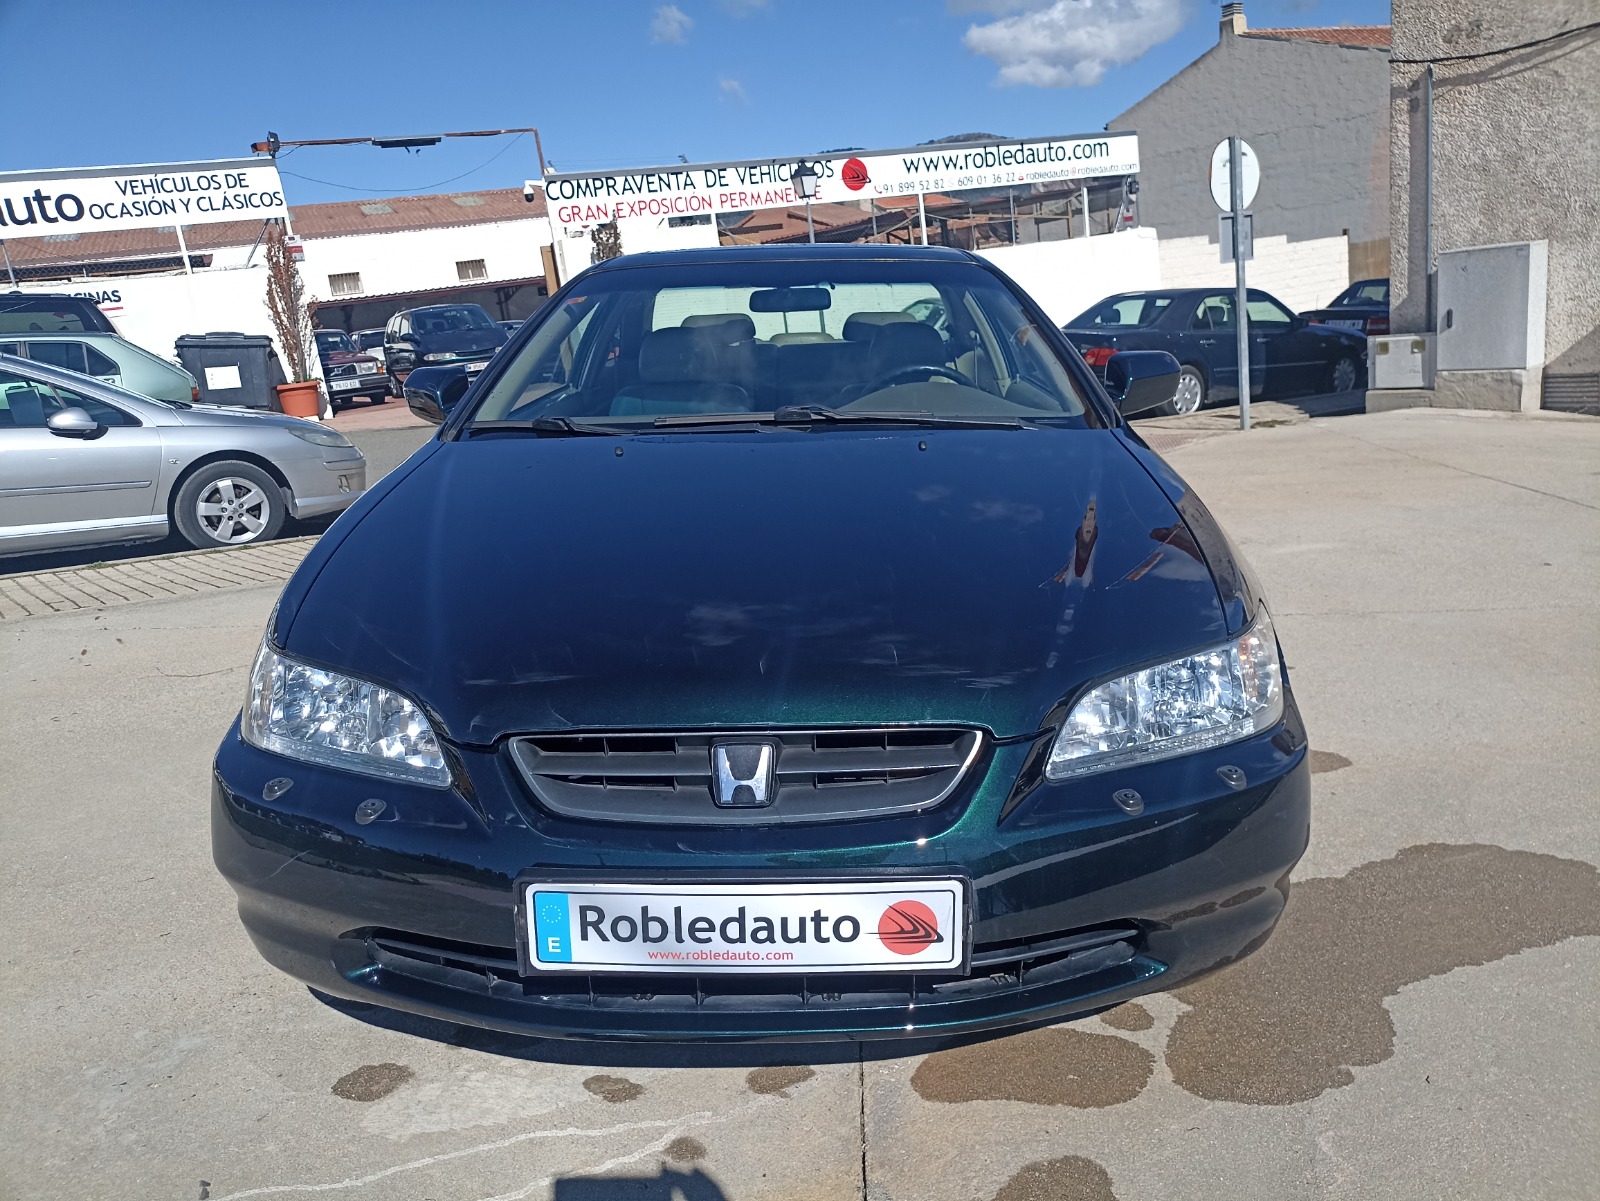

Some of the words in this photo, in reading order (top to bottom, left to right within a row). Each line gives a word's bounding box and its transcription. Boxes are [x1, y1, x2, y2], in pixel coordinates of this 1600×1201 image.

[903, 141, 1109, 174] www.robledauto.com
[114, 174, 222, 196] VEHÍCULOS
[225, 172, 249, 189] DE
[546, 172, 696, 201] COMPRAVENTA
[704, 168, 729, 188] DE
[883, 183, 894, 194] 91
[898, 182, 915, 193] 899
[919, 180, 930, 190] 52
[934, 179, 945, 189] 82
[957, 176, 974, 187] 609
[976, 175, 987, 184] 01
[992, 174, 1002, 184] 36
[1006, 172, 1016, 183] 22
[88, 196, 177, 220] OCASIÓN
[179, 198, 190, 213] Y
[196, 191, 284, 212] CLÁSICOS
[558, 203, 609, 223] GRAN
[616, 192, 713, 218] EXPOSICIÓN
[720, 185, 822, 208] PERMANEE
[578, 905, 861, 944] Robledauto
[548, 937, 560, 952] E
[648, 950, 794, 961] www.robledauto.com
